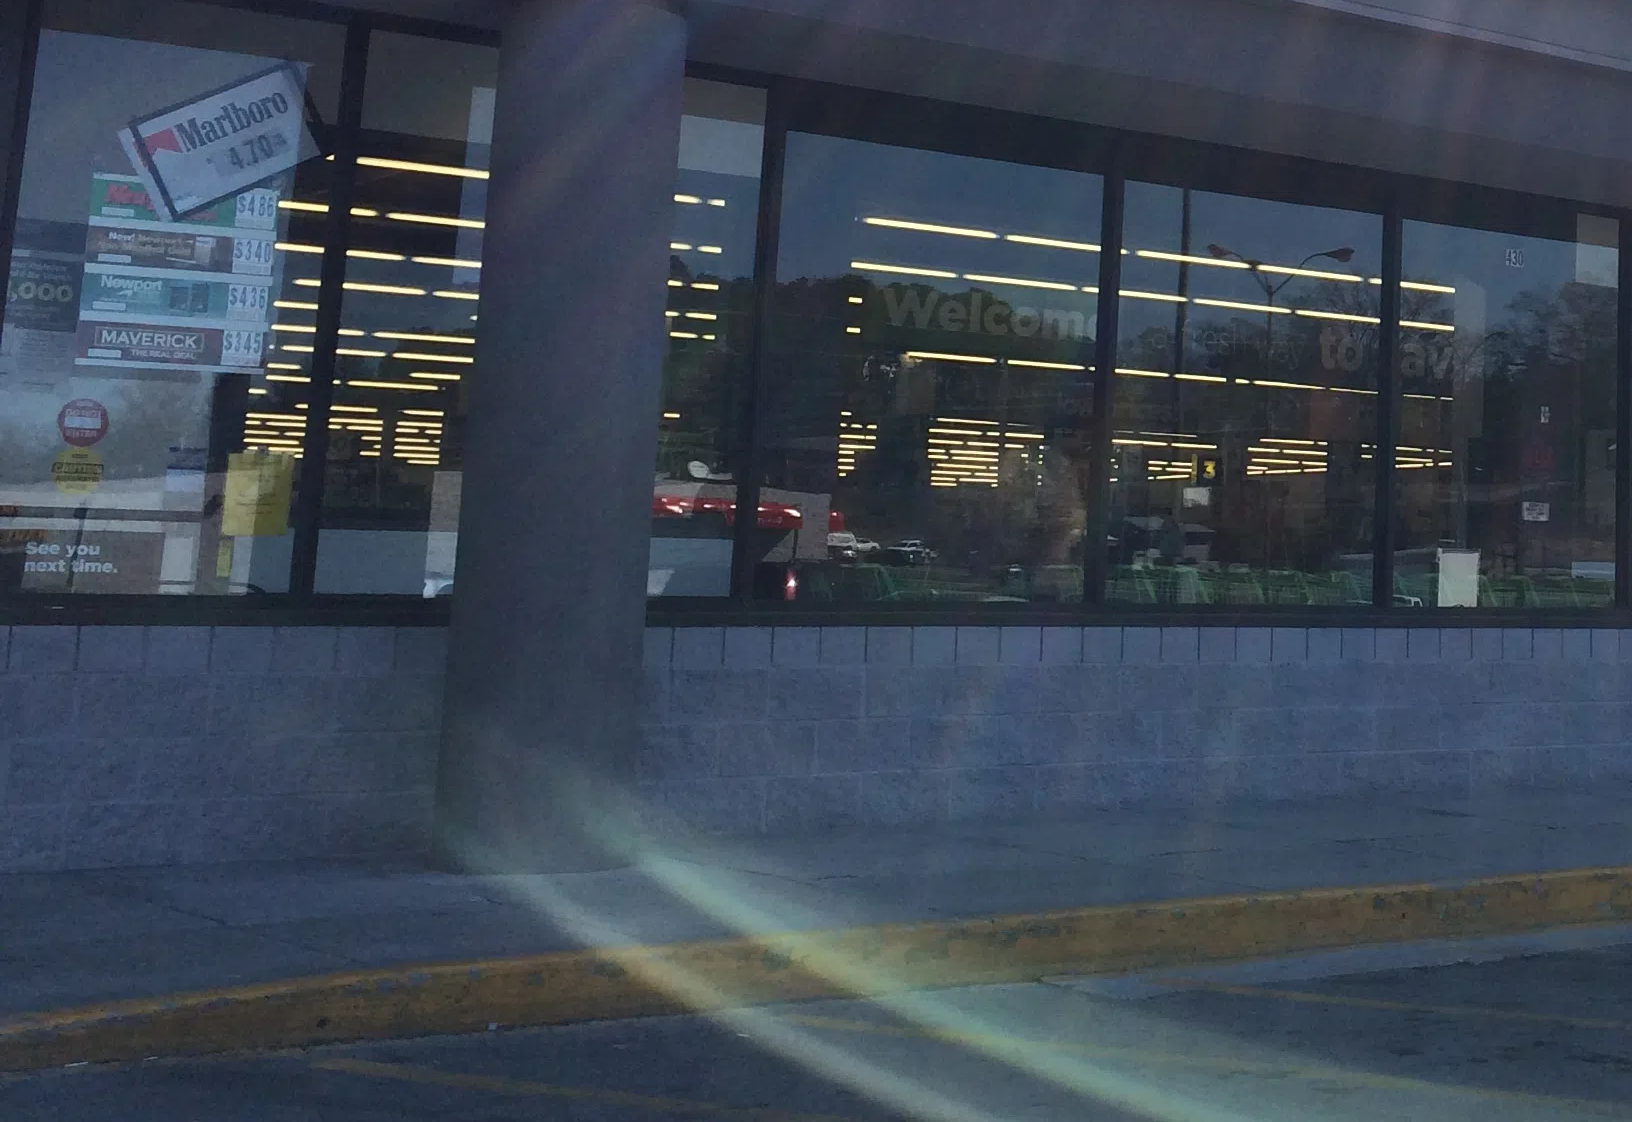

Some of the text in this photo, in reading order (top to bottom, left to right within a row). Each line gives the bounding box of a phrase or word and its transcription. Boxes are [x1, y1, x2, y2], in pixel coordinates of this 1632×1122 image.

[174, 91, 289, 153] Marlboro
[234, 239, 271, 264] $340
[100, 275, 163, 293] Newport
[101, 329, 197, 349] MAVERICK
[223, 330, 262, 355] $345
[25, 541, 101, 558] See you
[24, 558, 119, 574] next time.
